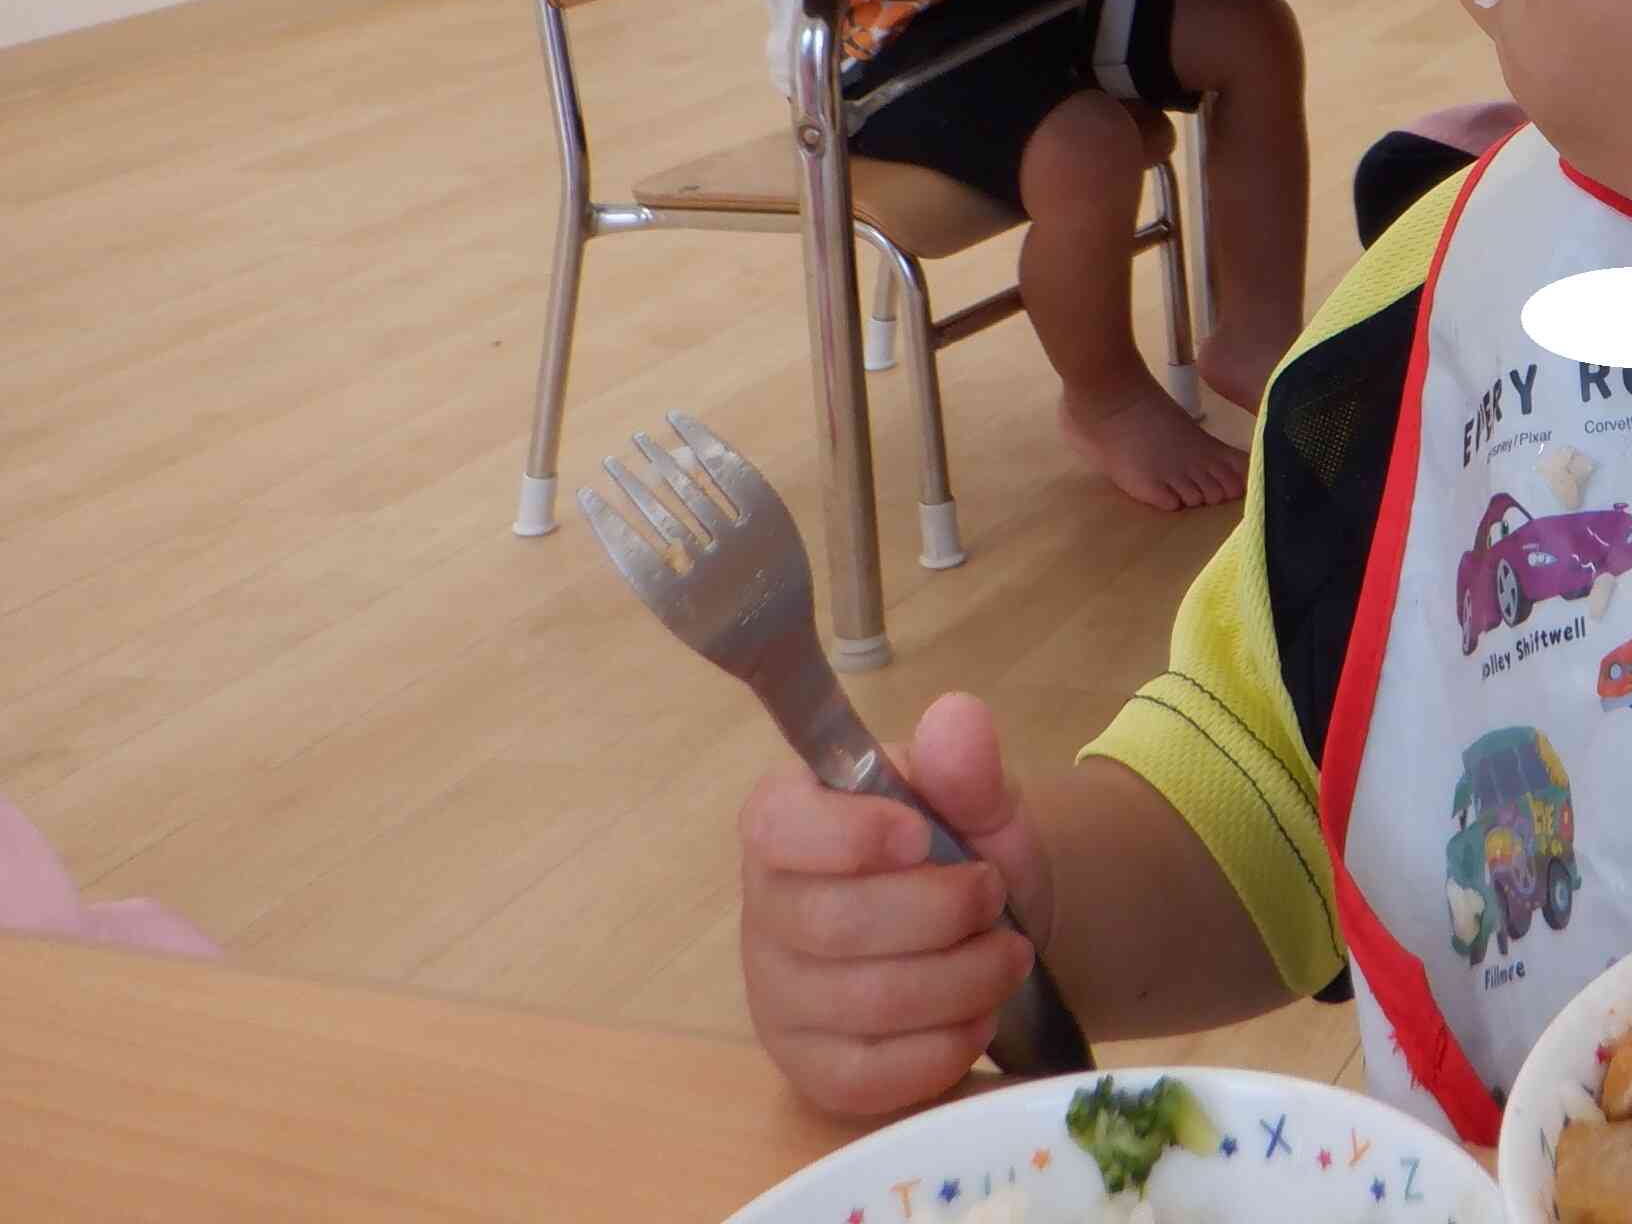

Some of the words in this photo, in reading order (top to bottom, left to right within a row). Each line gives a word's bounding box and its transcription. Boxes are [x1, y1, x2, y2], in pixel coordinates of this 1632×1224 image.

[1480, 651, 1511, 681] olley
[1515, 615, 1586, 662] Shiftwell
[890, 1176, 922, 1220] T
[1259, 1113, 1292, 1159] X
[1399, 1156, 1424, 1201] Z
